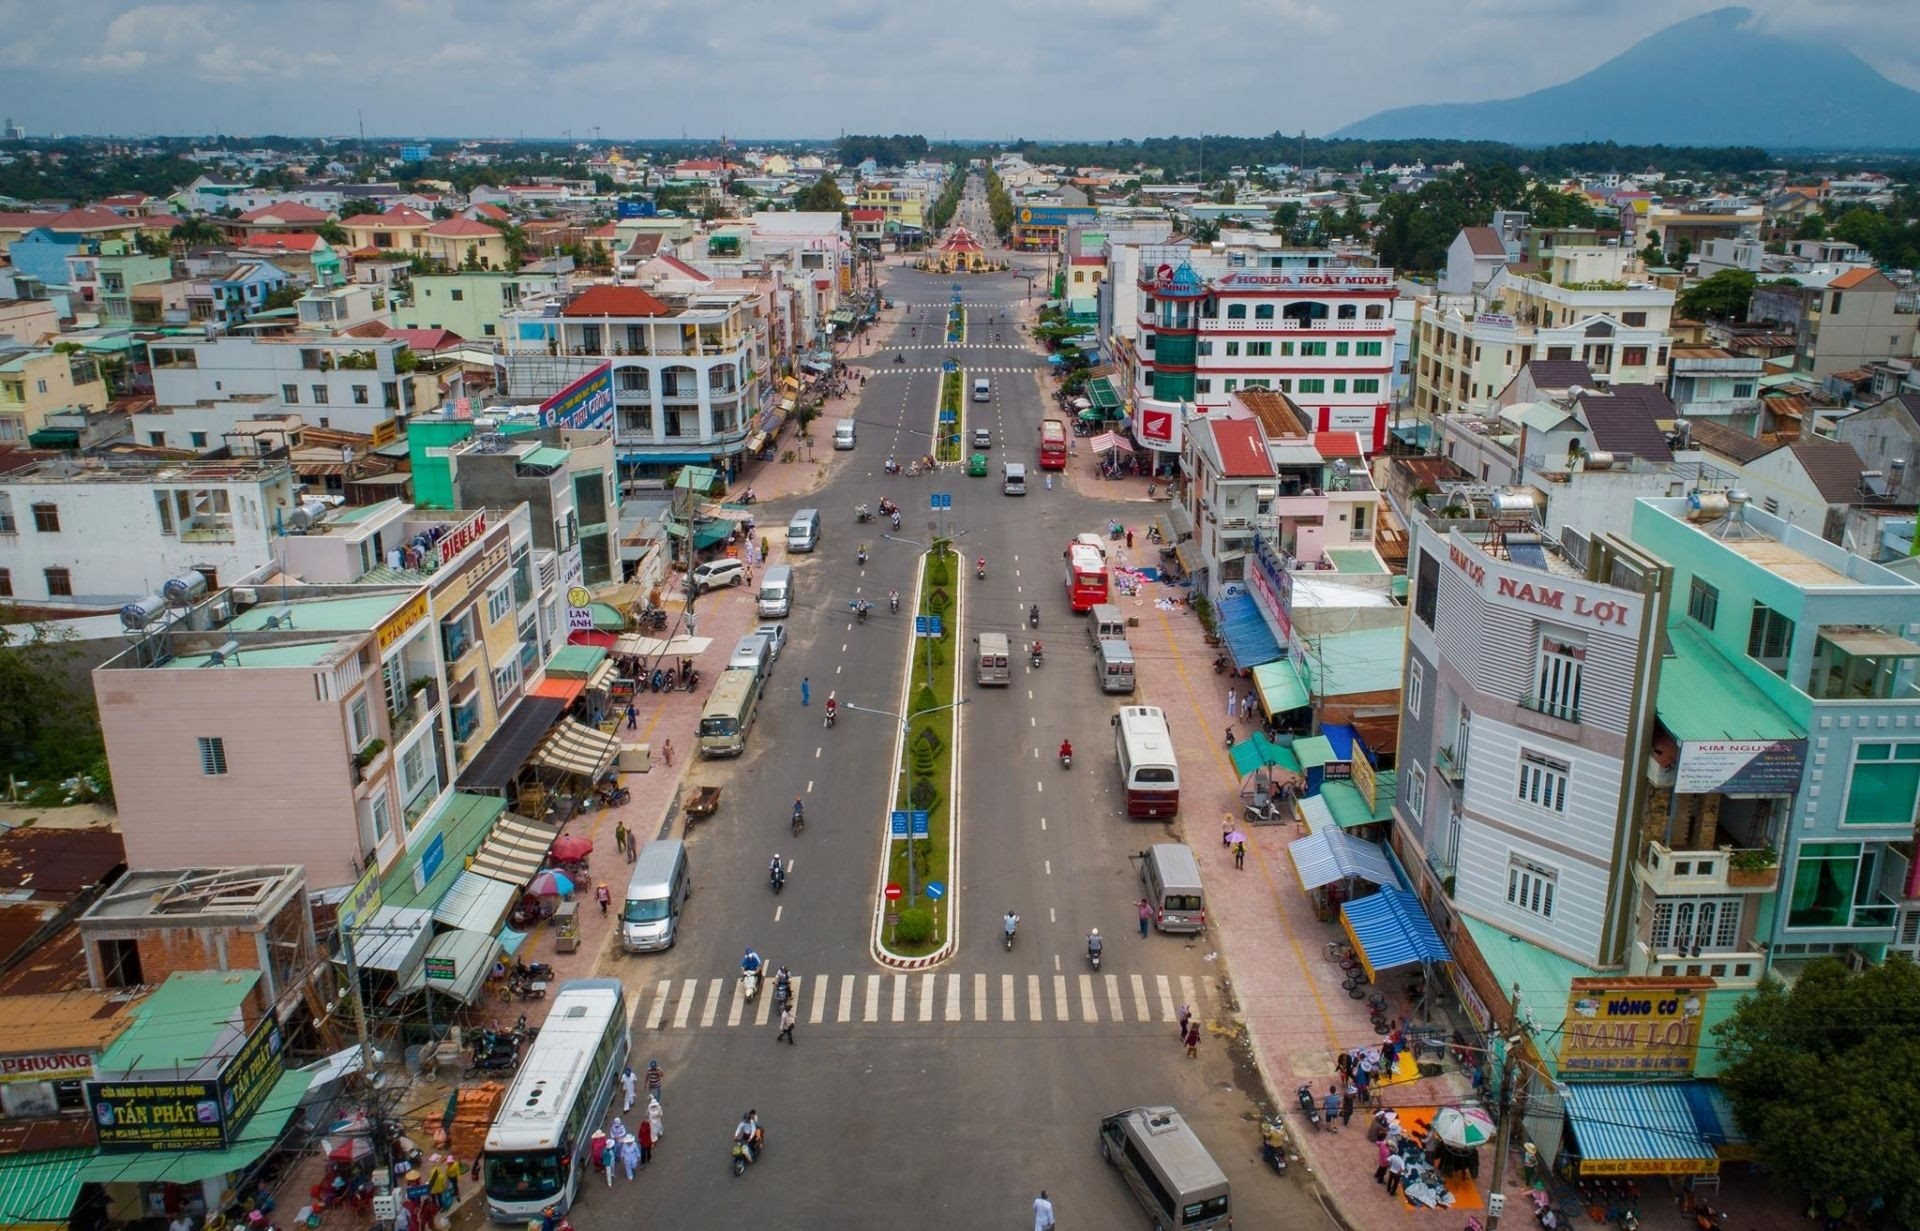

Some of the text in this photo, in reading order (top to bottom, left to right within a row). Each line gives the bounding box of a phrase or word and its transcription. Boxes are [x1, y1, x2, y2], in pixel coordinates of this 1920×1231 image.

[1237, 274, 1388, 285] HONDA HOÀI MINH
[1497, 577, 1628, 626] NAM LỢI
[569, 610, 590, 618] LAN
[1608, 997, 1679, 1015] NÔNG CƠ
[1570, 1016, 1697, 1055] NAM LỢI
[114, 1099, 196, 1124] TẤN PHÁT
[1630, 1161, 1665, 1171] NAM
